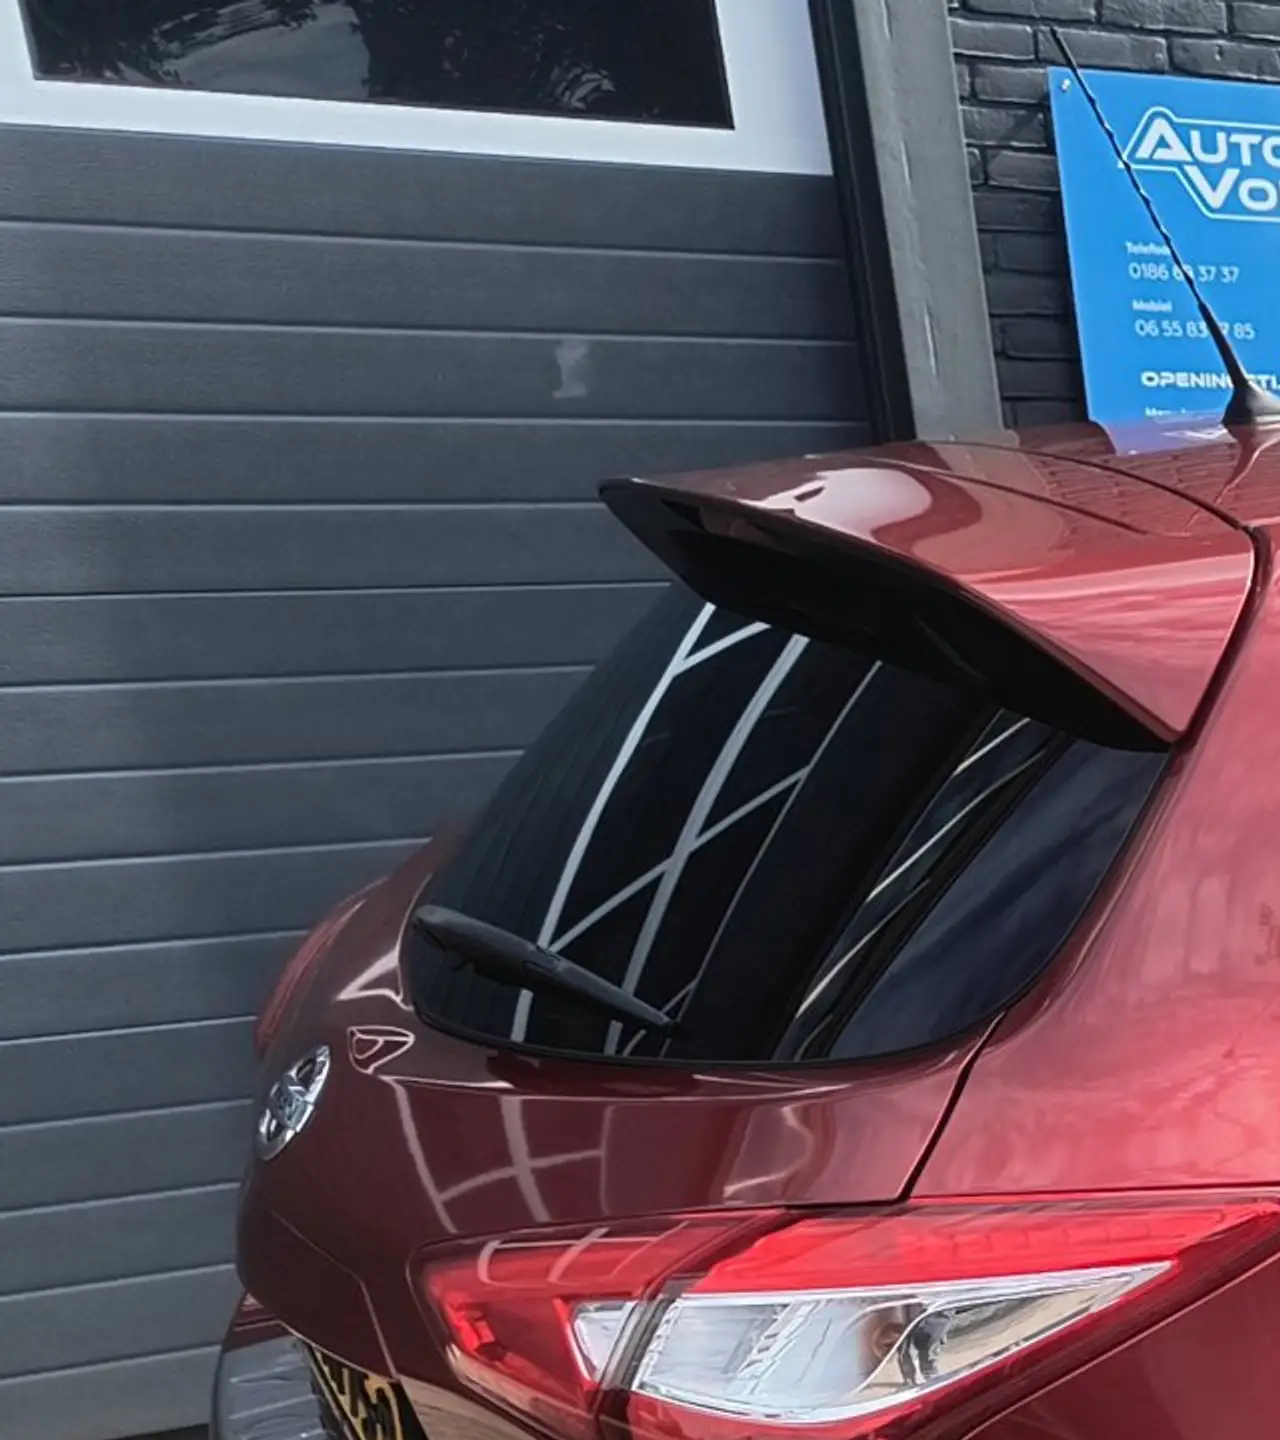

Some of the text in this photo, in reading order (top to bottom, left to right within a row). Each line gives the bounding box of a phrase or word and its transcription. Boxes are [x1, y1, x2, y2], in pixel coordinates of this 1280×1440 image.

[1128, 262, 1169, 281] 0186
[1198, 266, 1217, 283] 37
[1220, 266, 1240, 284] 37
[1135, 319, 1160, 337] 06
[1161, 320, 1184, 338] 55
[1233, 323, 1256, 340] 85
